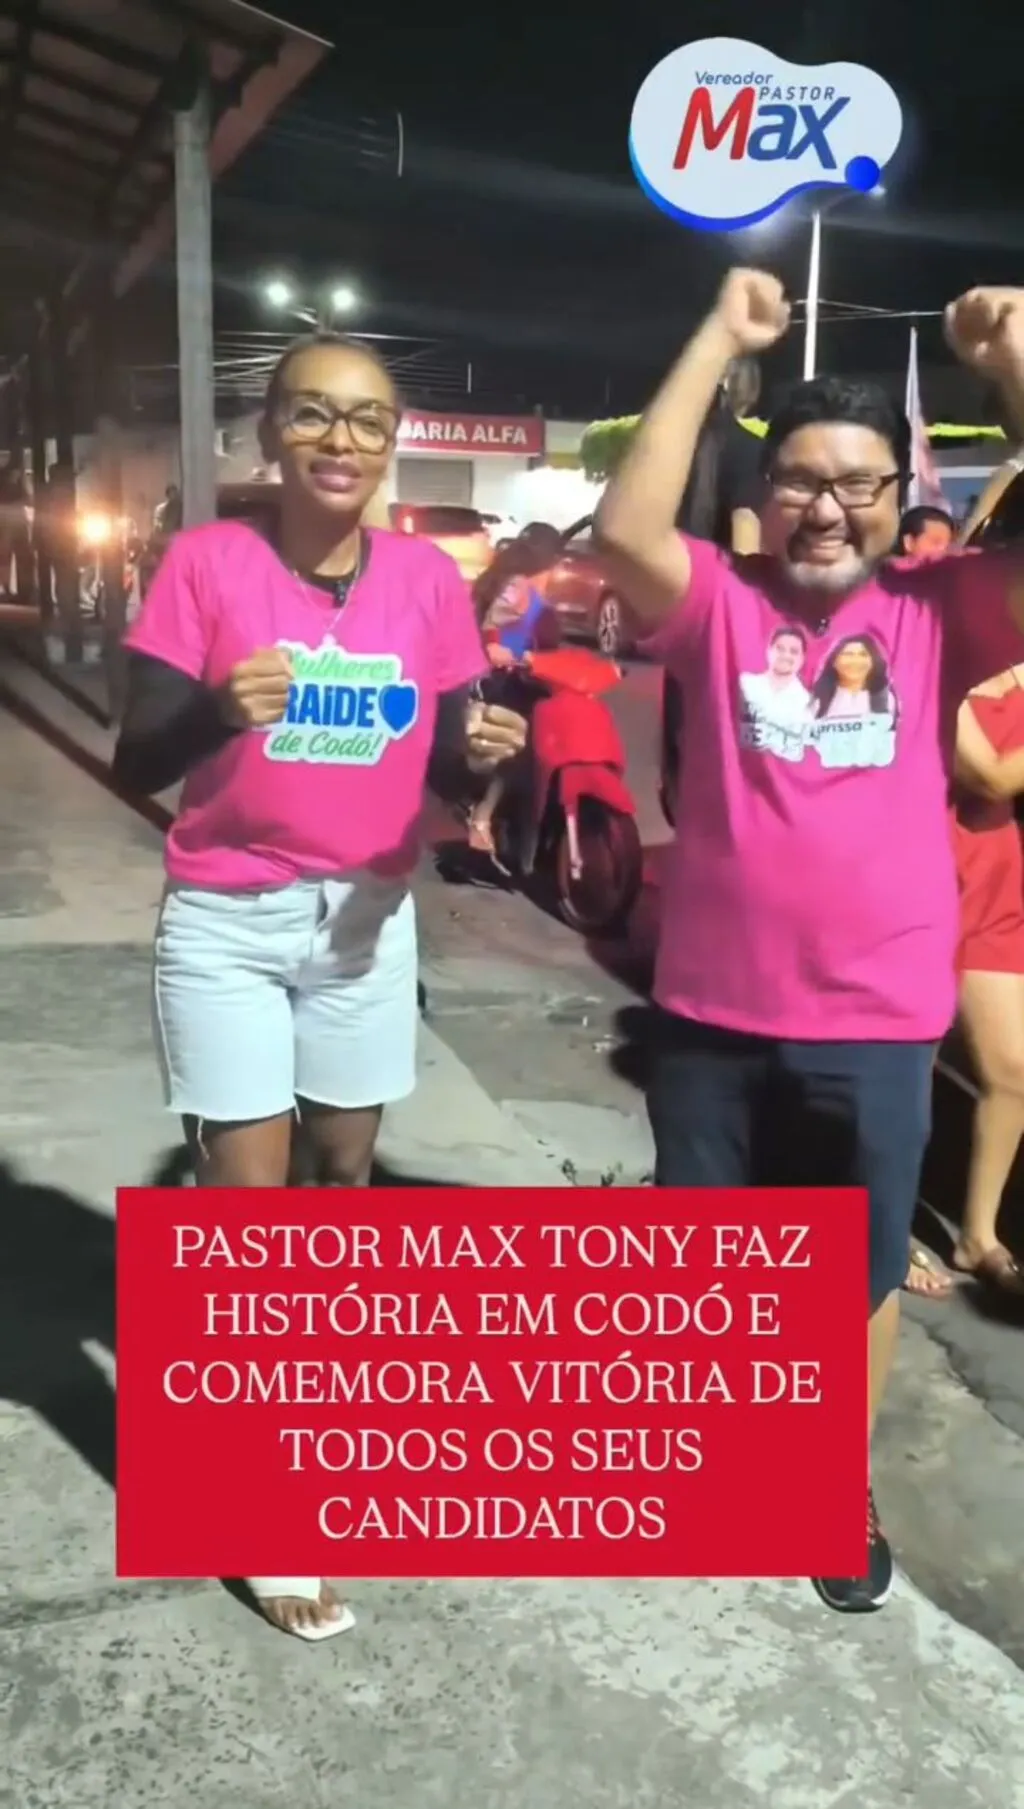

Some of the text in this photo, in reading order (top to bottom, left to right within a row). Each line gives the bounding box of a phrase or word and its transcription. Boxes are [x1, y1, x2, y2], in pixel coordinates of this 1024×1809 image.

[472, 423, 527, 445] ALFA
[271, 729, 384, 758] de Codó!
